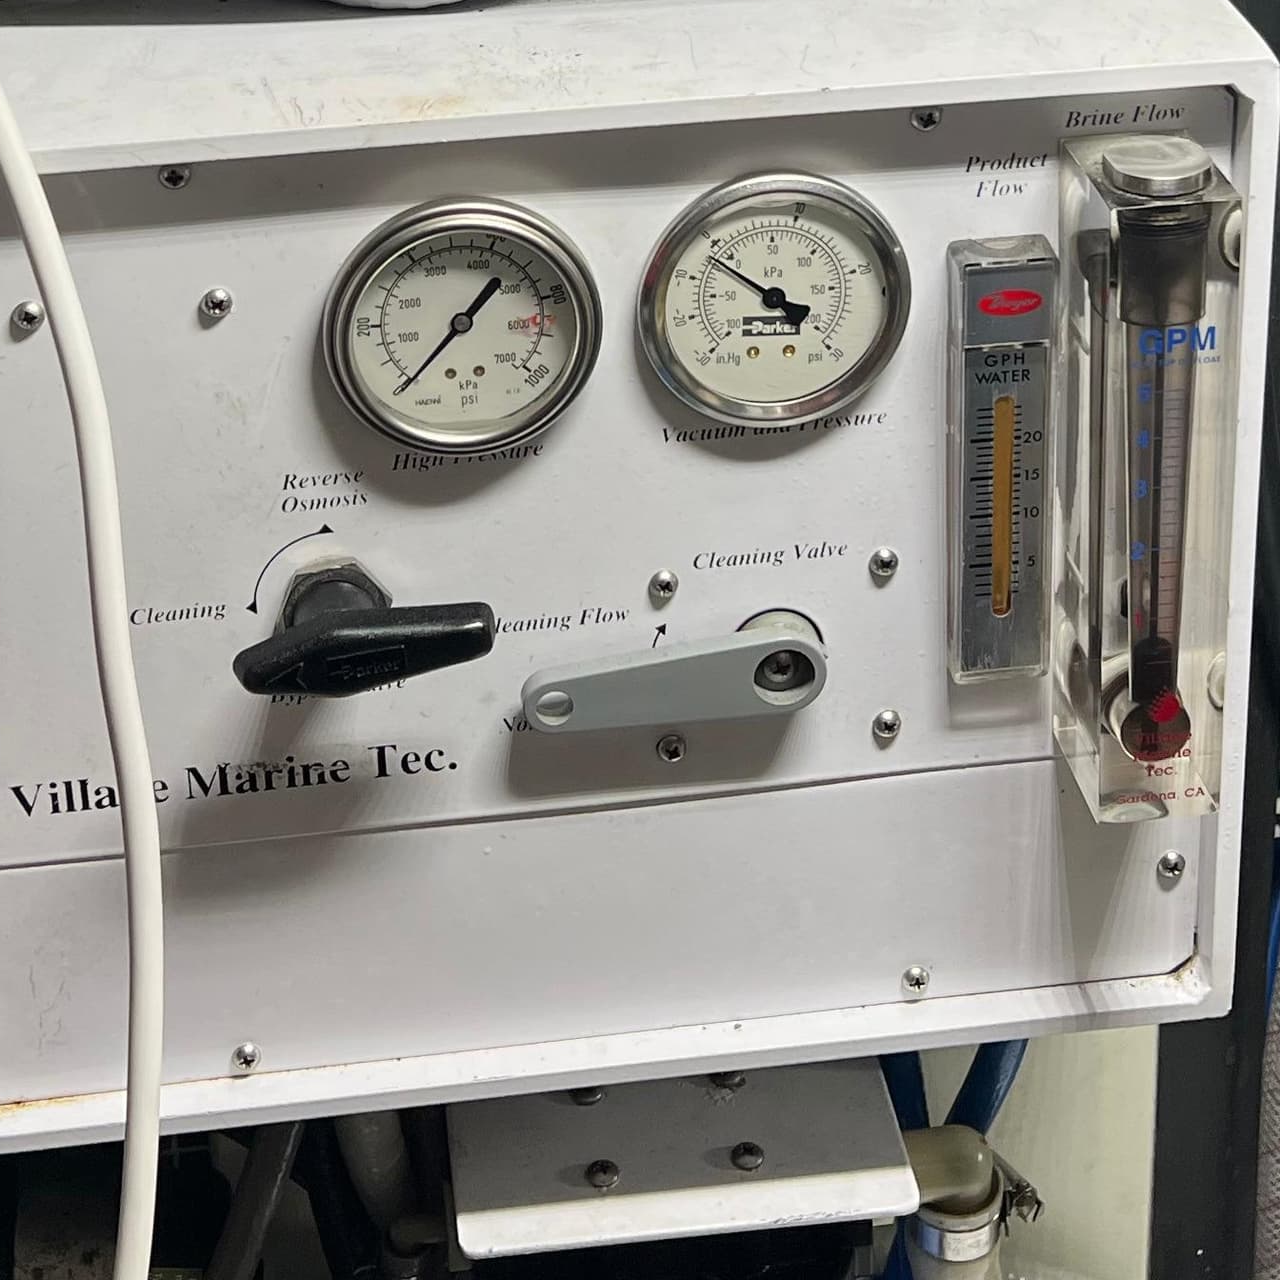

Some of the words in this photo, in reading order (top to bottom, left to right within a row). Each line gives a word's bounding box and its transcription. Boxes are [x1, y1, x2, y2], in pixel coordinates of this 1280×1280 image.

[1065, 109, 1124, 129] Brine
[1132, 104, 1186, 123] Flow
[966, 152, 1048, 173] Product
[976, 180, 1028, 198] Flow
[795, 202, 806, 214] 10
[767, 244, 779, 255] 50
[467, 259, 490, 271] 4000
[796, 257, 812, 268] 100
[423, 265, 447, 277] 3000
[763, 267, 783, 279] kPa
[857, 263, 872, 275] 20
[550, 283, 566, 305] 800
[810, 284, 826, 295] 150
[398, 298, 421, 309] 2000
[357, 316, 371, 337] 200
[398, 331, 419, 343] 1000
[1138, 326, 1217, 355] GPM
[494, 352, 517, 364] 7000
[715, 353, 741, 367] in.Hg
[808, 353, 823, 364] psi
[831, 348, 844, 363] 30
[984, 353, 1025, 368] GPH
[523, 363, 550, 388] 1000
[975, 369, 1031, 385] WATER
[458, 380, 478, 391] kPa
[461, 395, 479, 407] psi
[1023, 430, 1043, 443] 20
[282, 469, 364, 491] Reverse
[1023, 469, 1040, 480] 15
[281, 491, 368, 513] Osmosis
[1023, 507, 1040, 518] 10
[692, 548, 785, 570] Cleaning
[793, 541, 848, 561] Valve
[1027, 556, 1036, 567] 5
[130, 603, 227, 626] Cleaning
[495, 612, 570, 634] leaning
[579, 607, 630, 626] Flow
[9, 775, 169, 817] Villae
[185, 755, 350, 799] Marine
[369, 744, 459, 778] Tec.
[1184, 787, 1206, 798] CA
